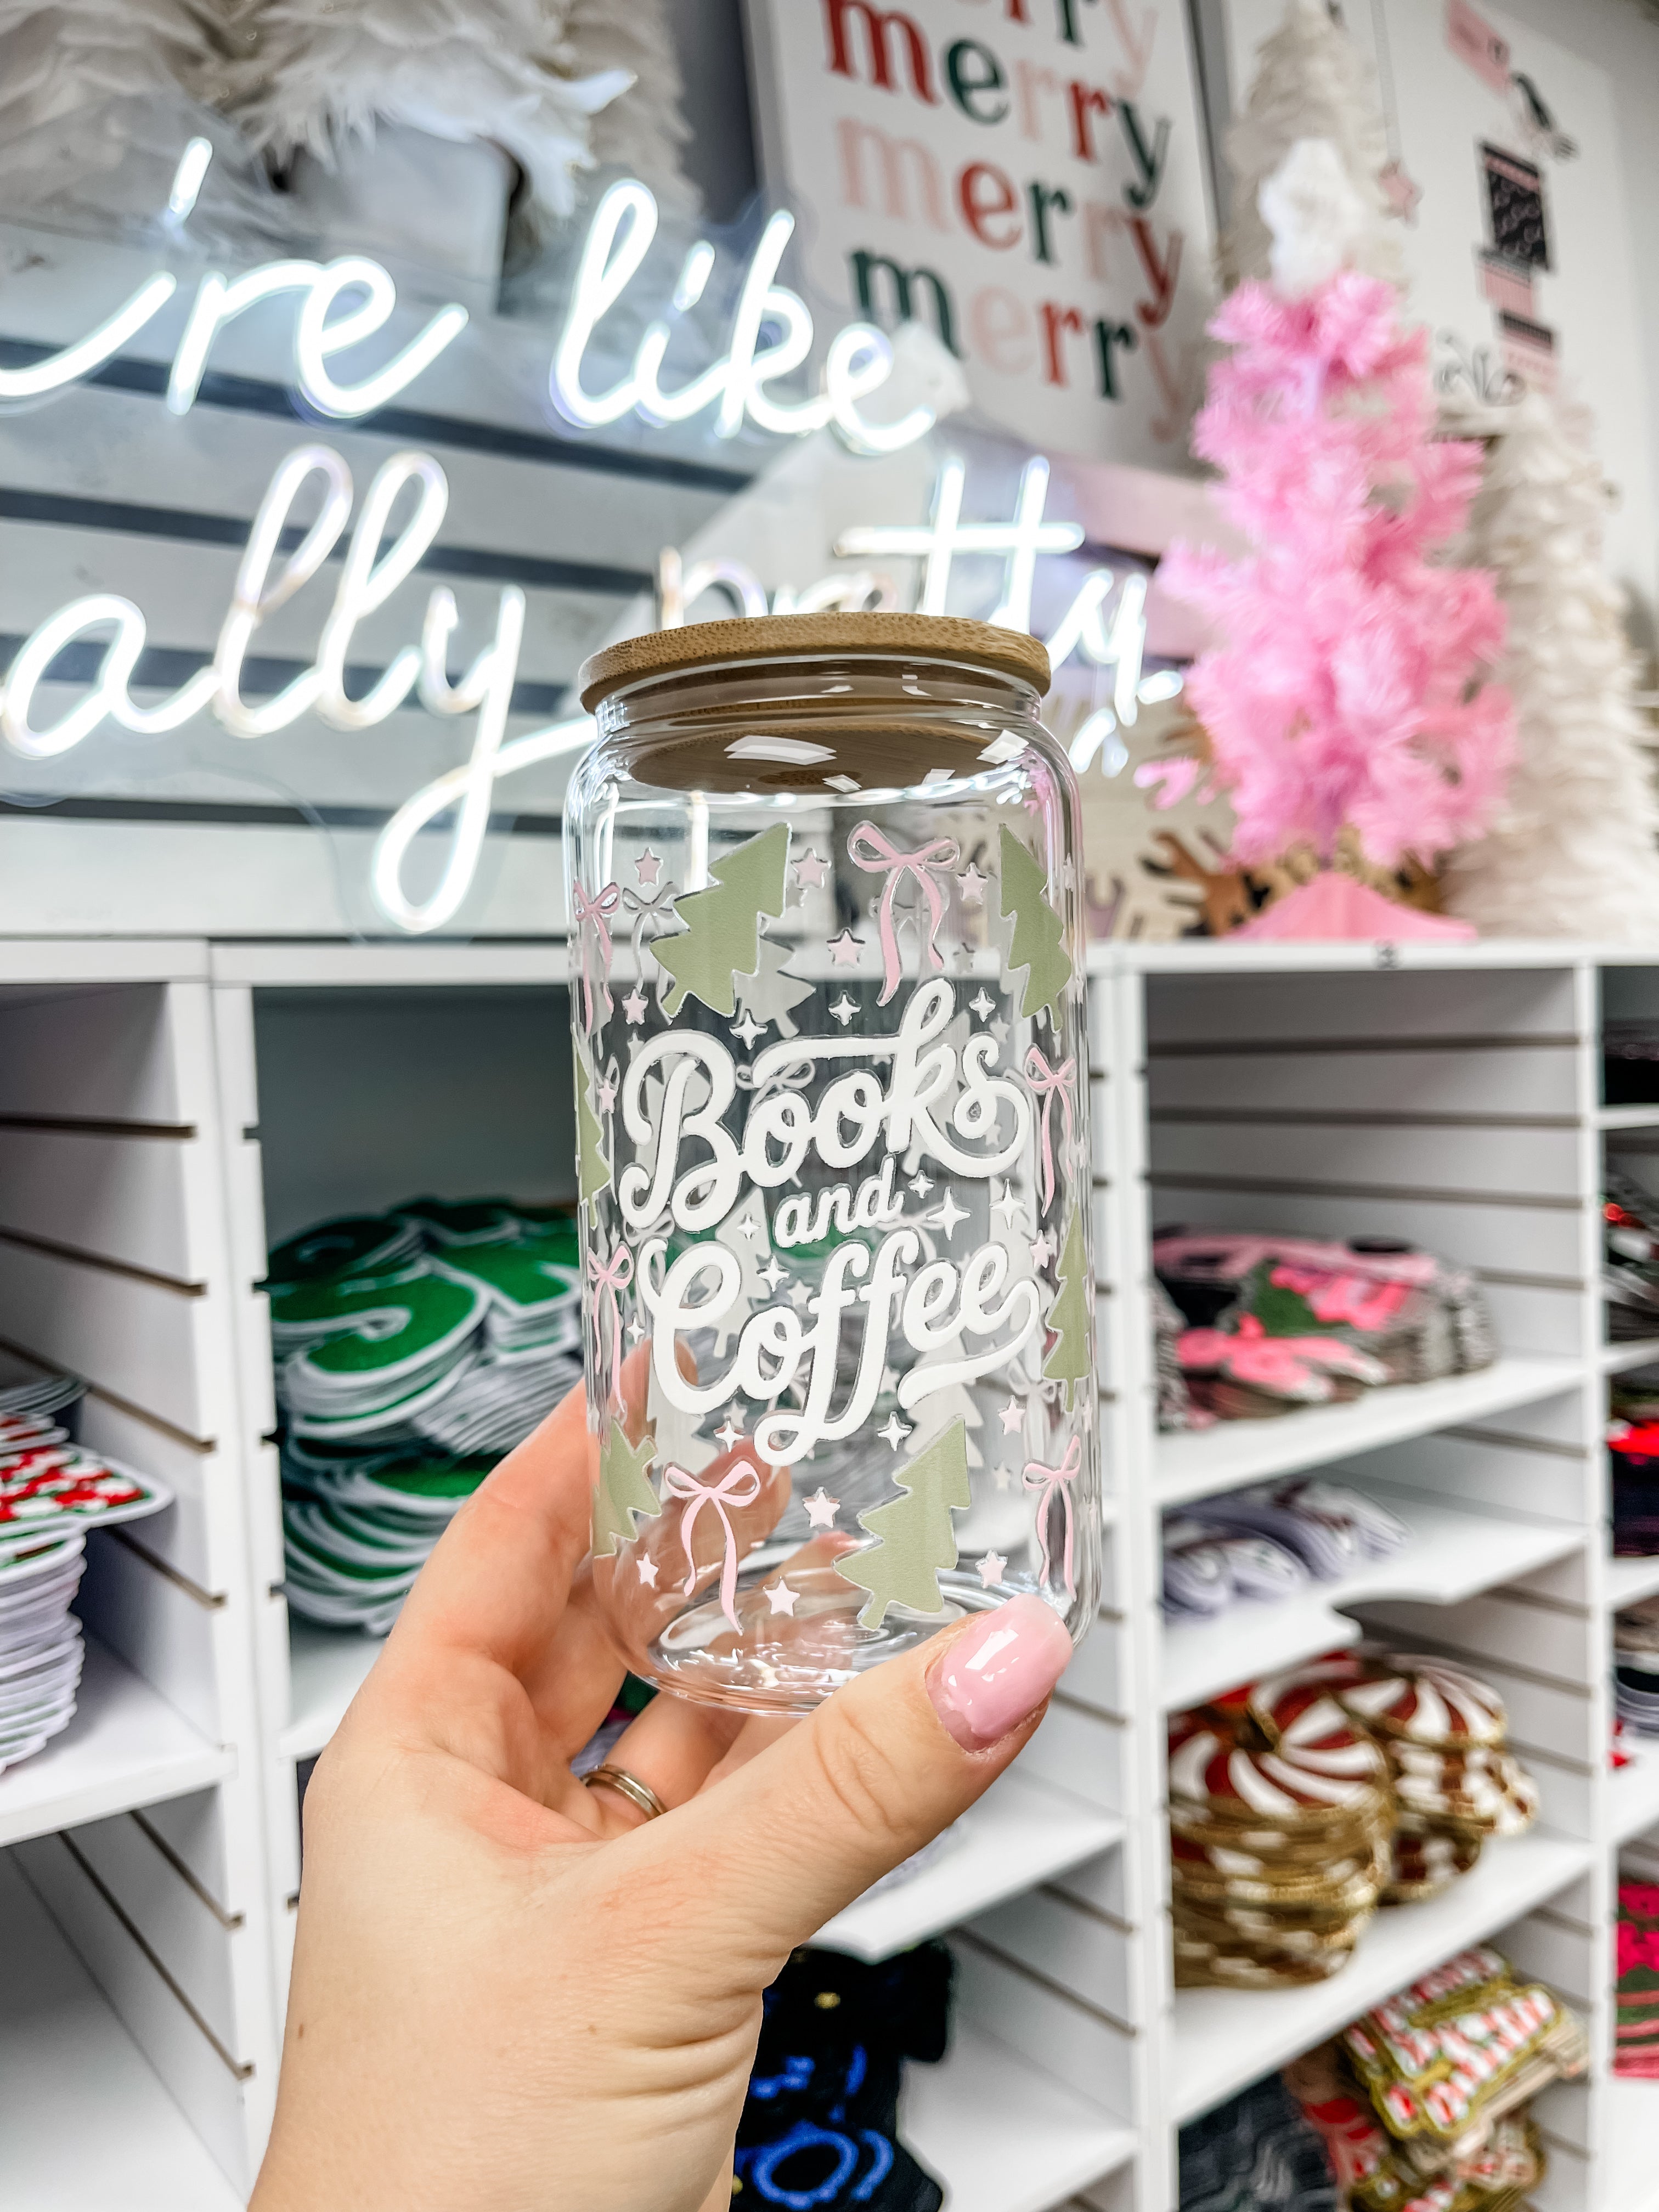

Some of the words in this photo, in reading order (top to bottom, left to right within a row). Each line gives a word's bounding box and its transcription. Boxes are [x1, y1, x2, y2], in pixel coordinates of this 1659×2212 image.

[819, 0, 1172, 208] merry
[550, 178, 938, 456] like
[837, 116, 1185, 327] merry
[846, 247, 1199, 442] merry
[620, 977, 1031, 1234] Books
[773, 1153, 906, 1248] and
[637, 1226, 1041, 1466] Coffee
